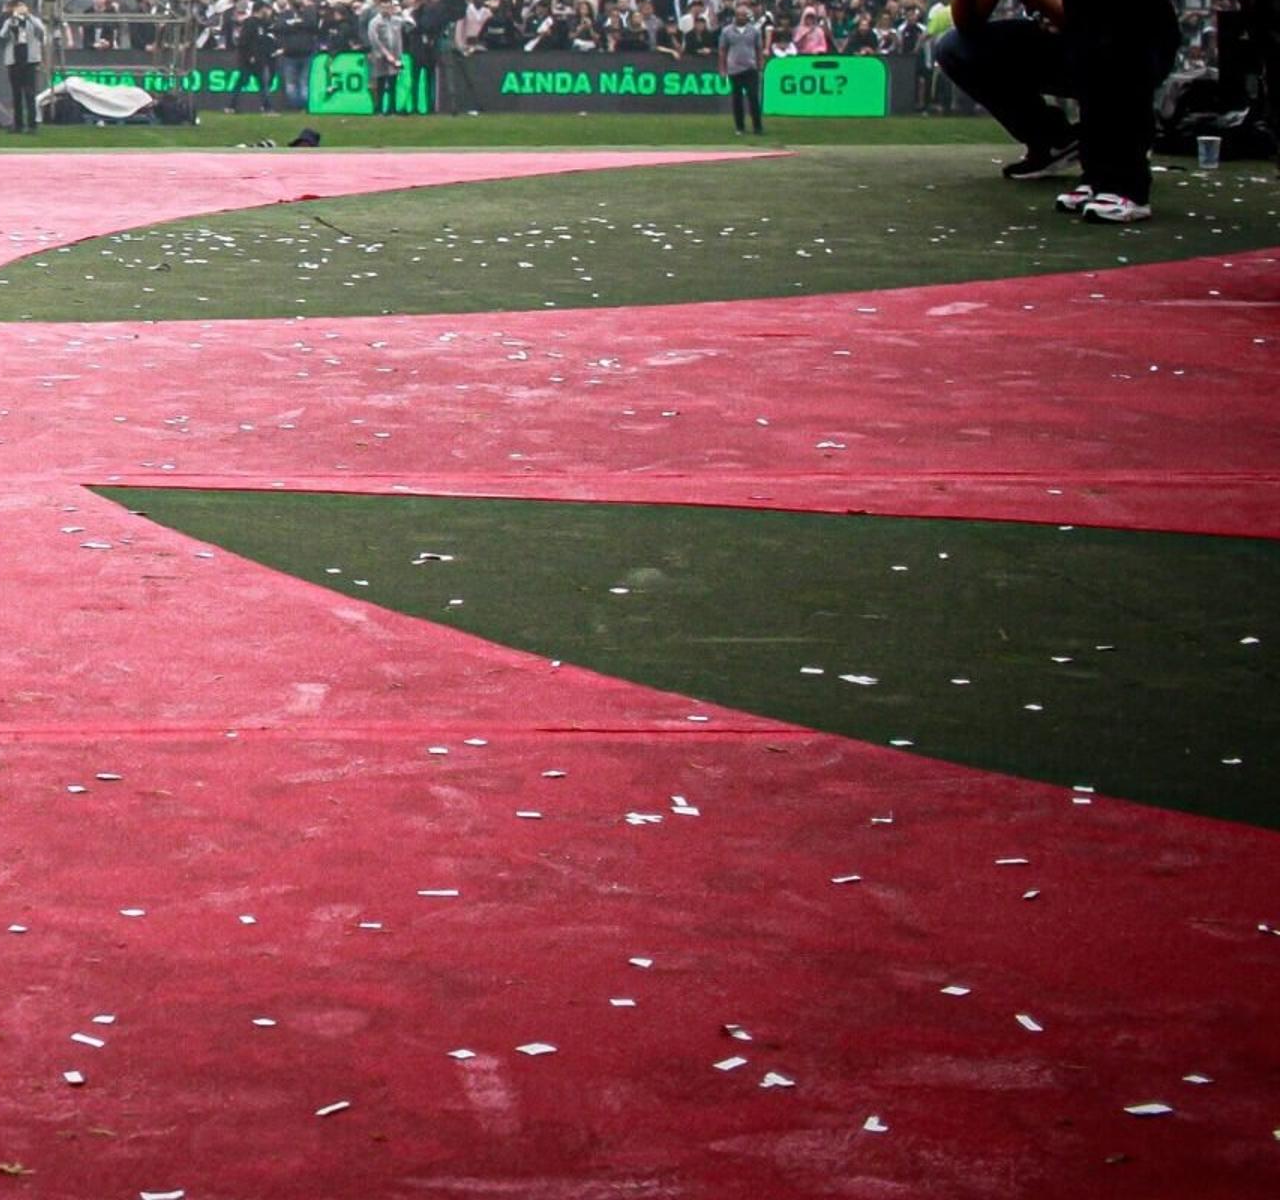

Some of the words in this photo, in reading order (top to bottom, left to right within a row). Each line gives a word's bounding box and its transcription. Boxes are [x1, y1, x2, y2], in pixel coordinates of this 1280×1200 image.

[501, 72, 591, 94] AINDA
[600, 67, 655, 94] NÃO
[663, 73, 733, 95] SAIU
[780, 75, 848, 95] GOL?
